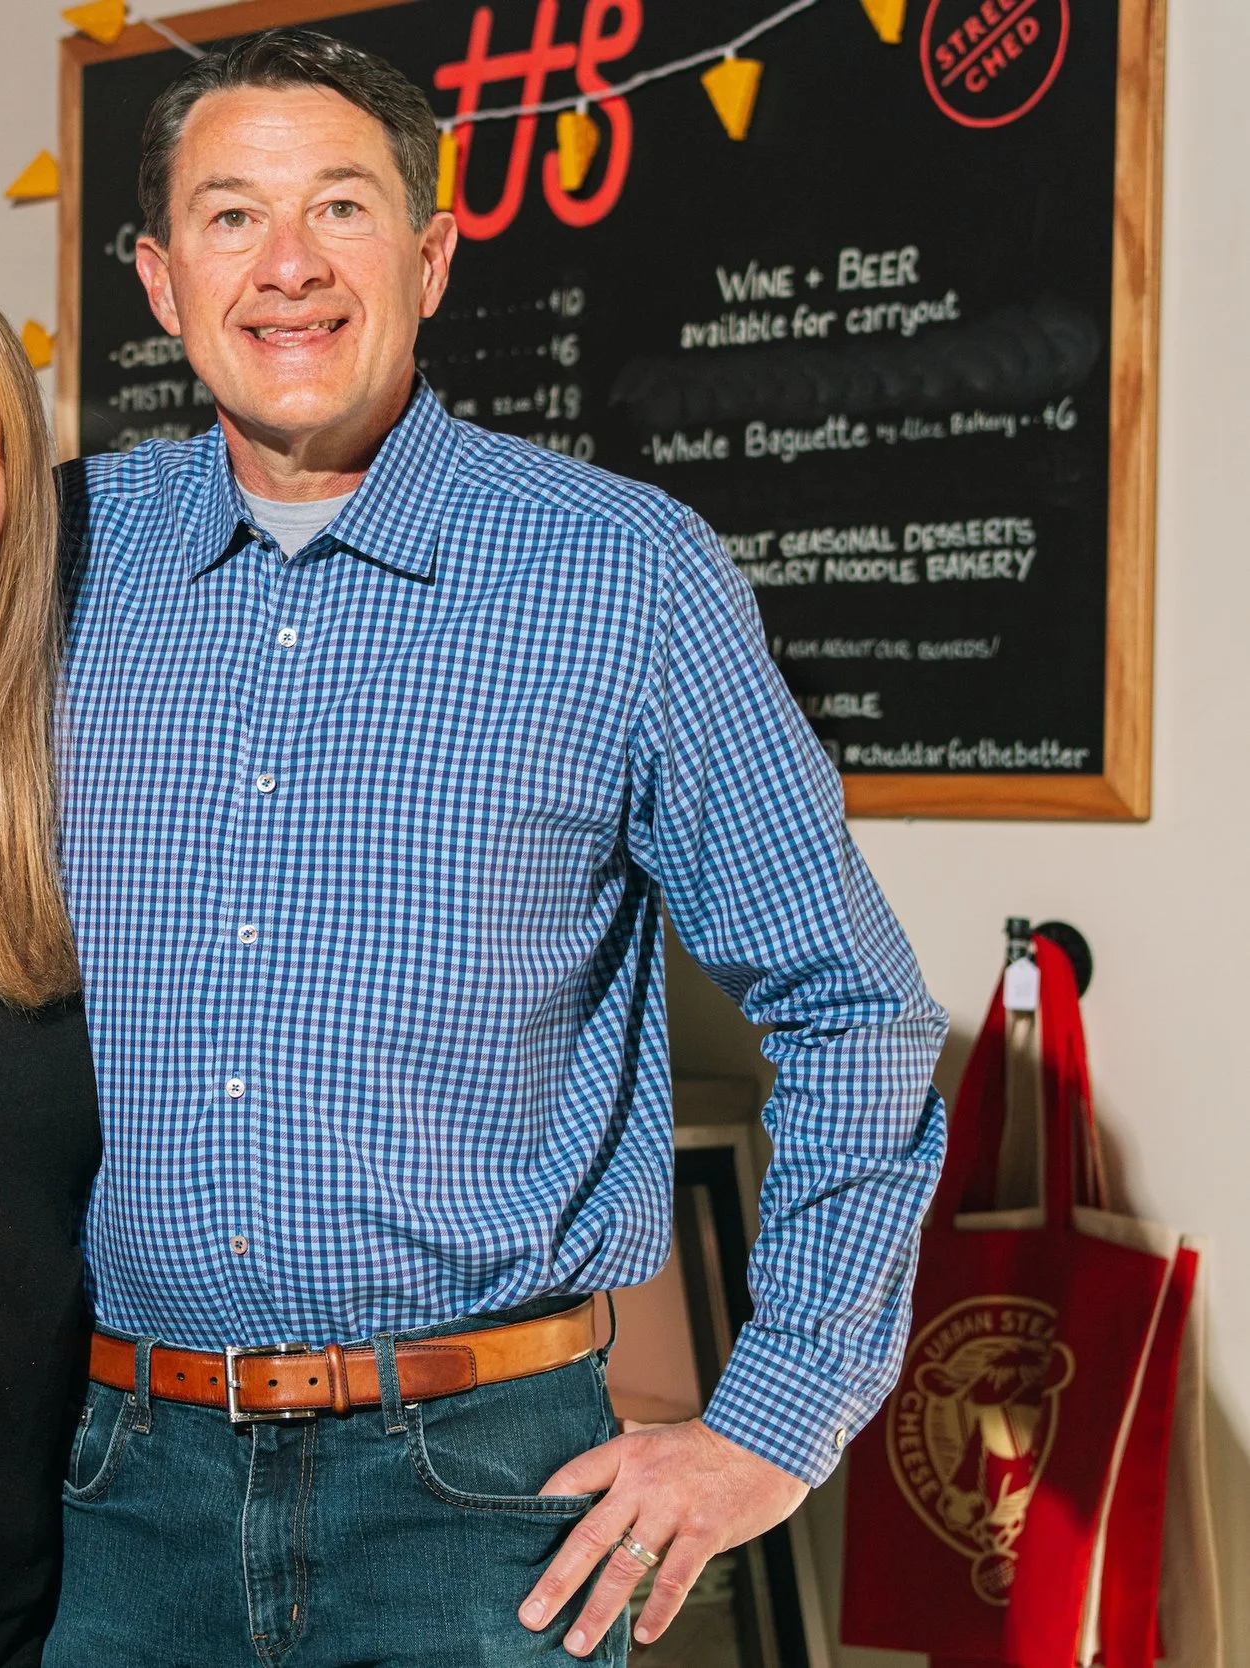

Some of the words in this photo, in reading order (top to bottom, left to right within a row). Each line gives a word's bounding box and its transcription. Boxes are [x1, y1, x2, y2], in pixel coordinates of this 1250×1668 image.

[964, 16, 1040, 93] CHED
[715, 259, 795, 303] WINE
[837, 245, 920, 291] BEER
[680, 309, 787, 349] available
[790, 303, 838, 338] for
[846, 288, 961, 337] carryout
[652, 428, 730, 464] Whole
[745, 414, 870, 464] Baguette
[718, 530, 776, 560] OUT
[779, 526, 896, 557] SEASONAL
[904, 517, 1036, 552] DESSERTS
[740, 558, 820, 588] NGRY
[823, 556, 921, 585] NOODLE
[926, 548, 1037, 582] BAKERY
[1000, 1309, 1056, 1340] STE
[897, 1390, 943, 1501] CHEESE
